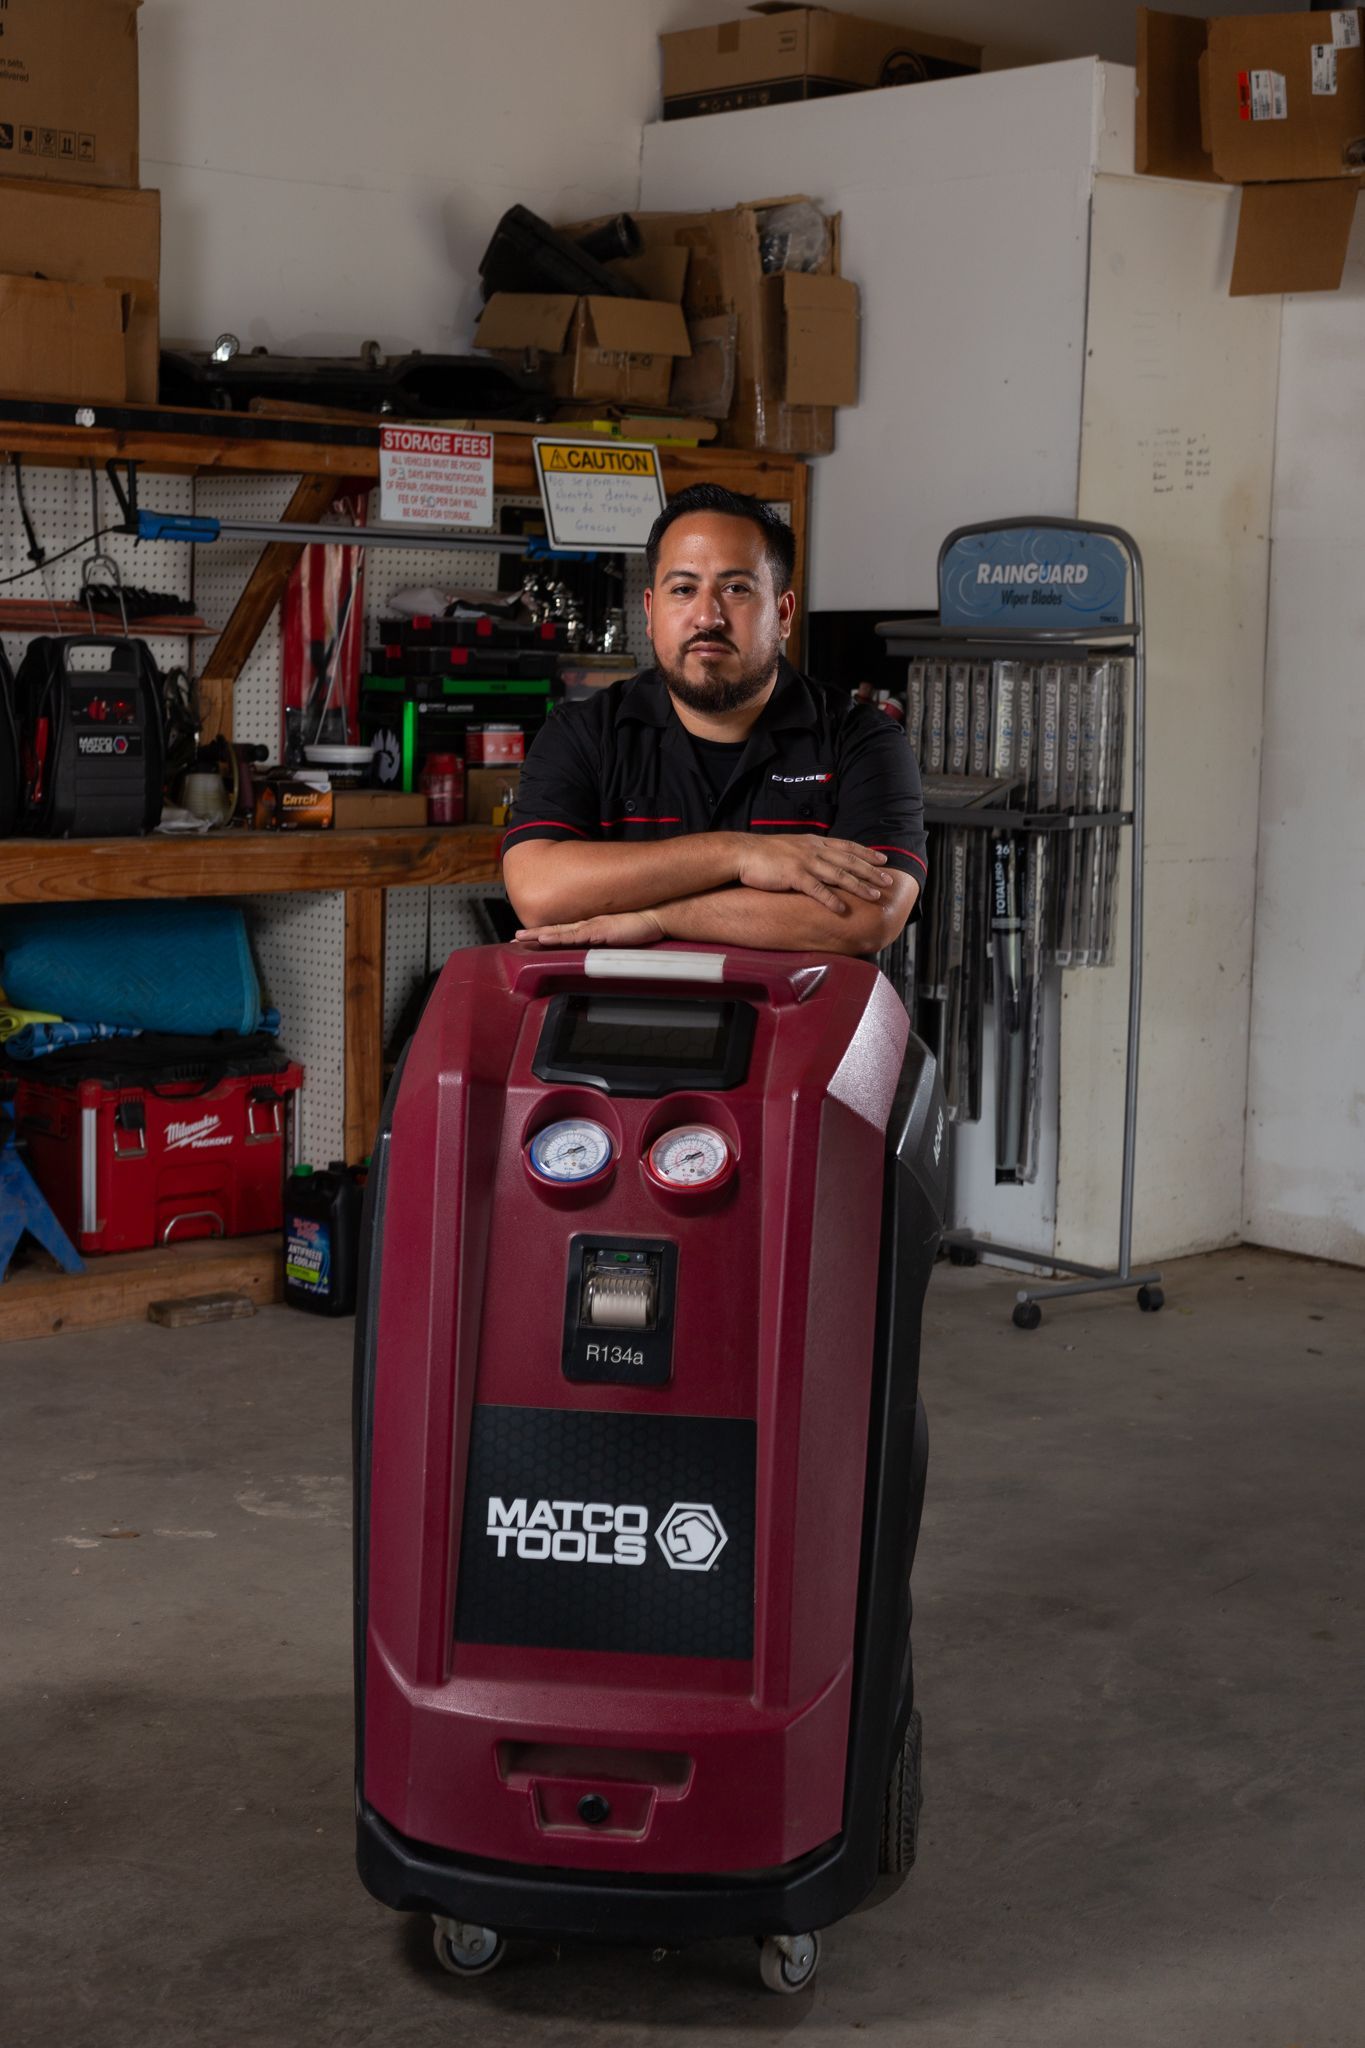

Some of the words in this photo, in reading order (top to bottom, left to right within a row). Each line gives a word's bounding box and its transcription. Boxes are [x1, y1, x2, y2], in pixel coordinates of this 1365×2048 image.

[384, 430, 451, 453] STORAGE
[454, 436, 488, 456] FEES
[391, 456, 402, 465] ALL
[404, 457, 431, 467] VEHICLES
[432, 458, 449, 468] MUST
[450, 460, 459, 469] BE
[460, 461, 481, 471] PICKED
[567, 450, 648, 471] CAUTION
[388, 468, 397, 477] UP
[408, 469, 424, 479] DAYS
[425, 471, 443, 480] AFTER
[444, 472, 484, 483] NOTIFICATION
[385, 480, 394, 490] OF
[419, 483, 453, 494] OTHERWISE
[460, 487, 487, 497] STORAGE
[398, 494, 409, 504] FEE
[410, 495, 419, 504] OF
[435, 497, 448, 506] PER
[449, 497, 462, 507] DAY
[463, 498, 478, 508] WILL
[402, 508, 411, 517] BE
[412, 508, 429, 518] MADE
[430, 509, 442, 519] FOR
[976, 561, 1089, 585] RAINGUARD
[1001, 590, 1030, 609] Wiper
[1031, 589, 1063, 606] Blades
[931, 682, 943, 768] RAINGUARD
[953, 681, 965, 768] RAINGUARD
[974, 683, 986, 771] RAINGUARD
[999, 679, 1015, 768] RAINGUARD
[1018, 680, 1031, 769] RAINGUARD
[1043, 682, 1057, 772] RAINGUARD
[1065, 682, 1079, 773] RAINGUARD
[79, 736, 113, 745] MATCO
[80, 744, 113, 753] TOOLS
[771, 774, 826, 783] DODGE
[995, 844, 1010, 856] 26
[952, 846, 964, 933] RAINGUARD
[163, 1114, 219, 1144] Milwaukee
[191, 1135, 233, 1148] PACKOUT
[288, 1243, 322, 1261] ANTIFREEZE
[293, 1255, 320, 1271] COOLANT
[586, 1344, 644, 1365] R134a
[487, 1496, 649, 1535] MATCO
[486, 1526, 648, 1566] TOOLS
